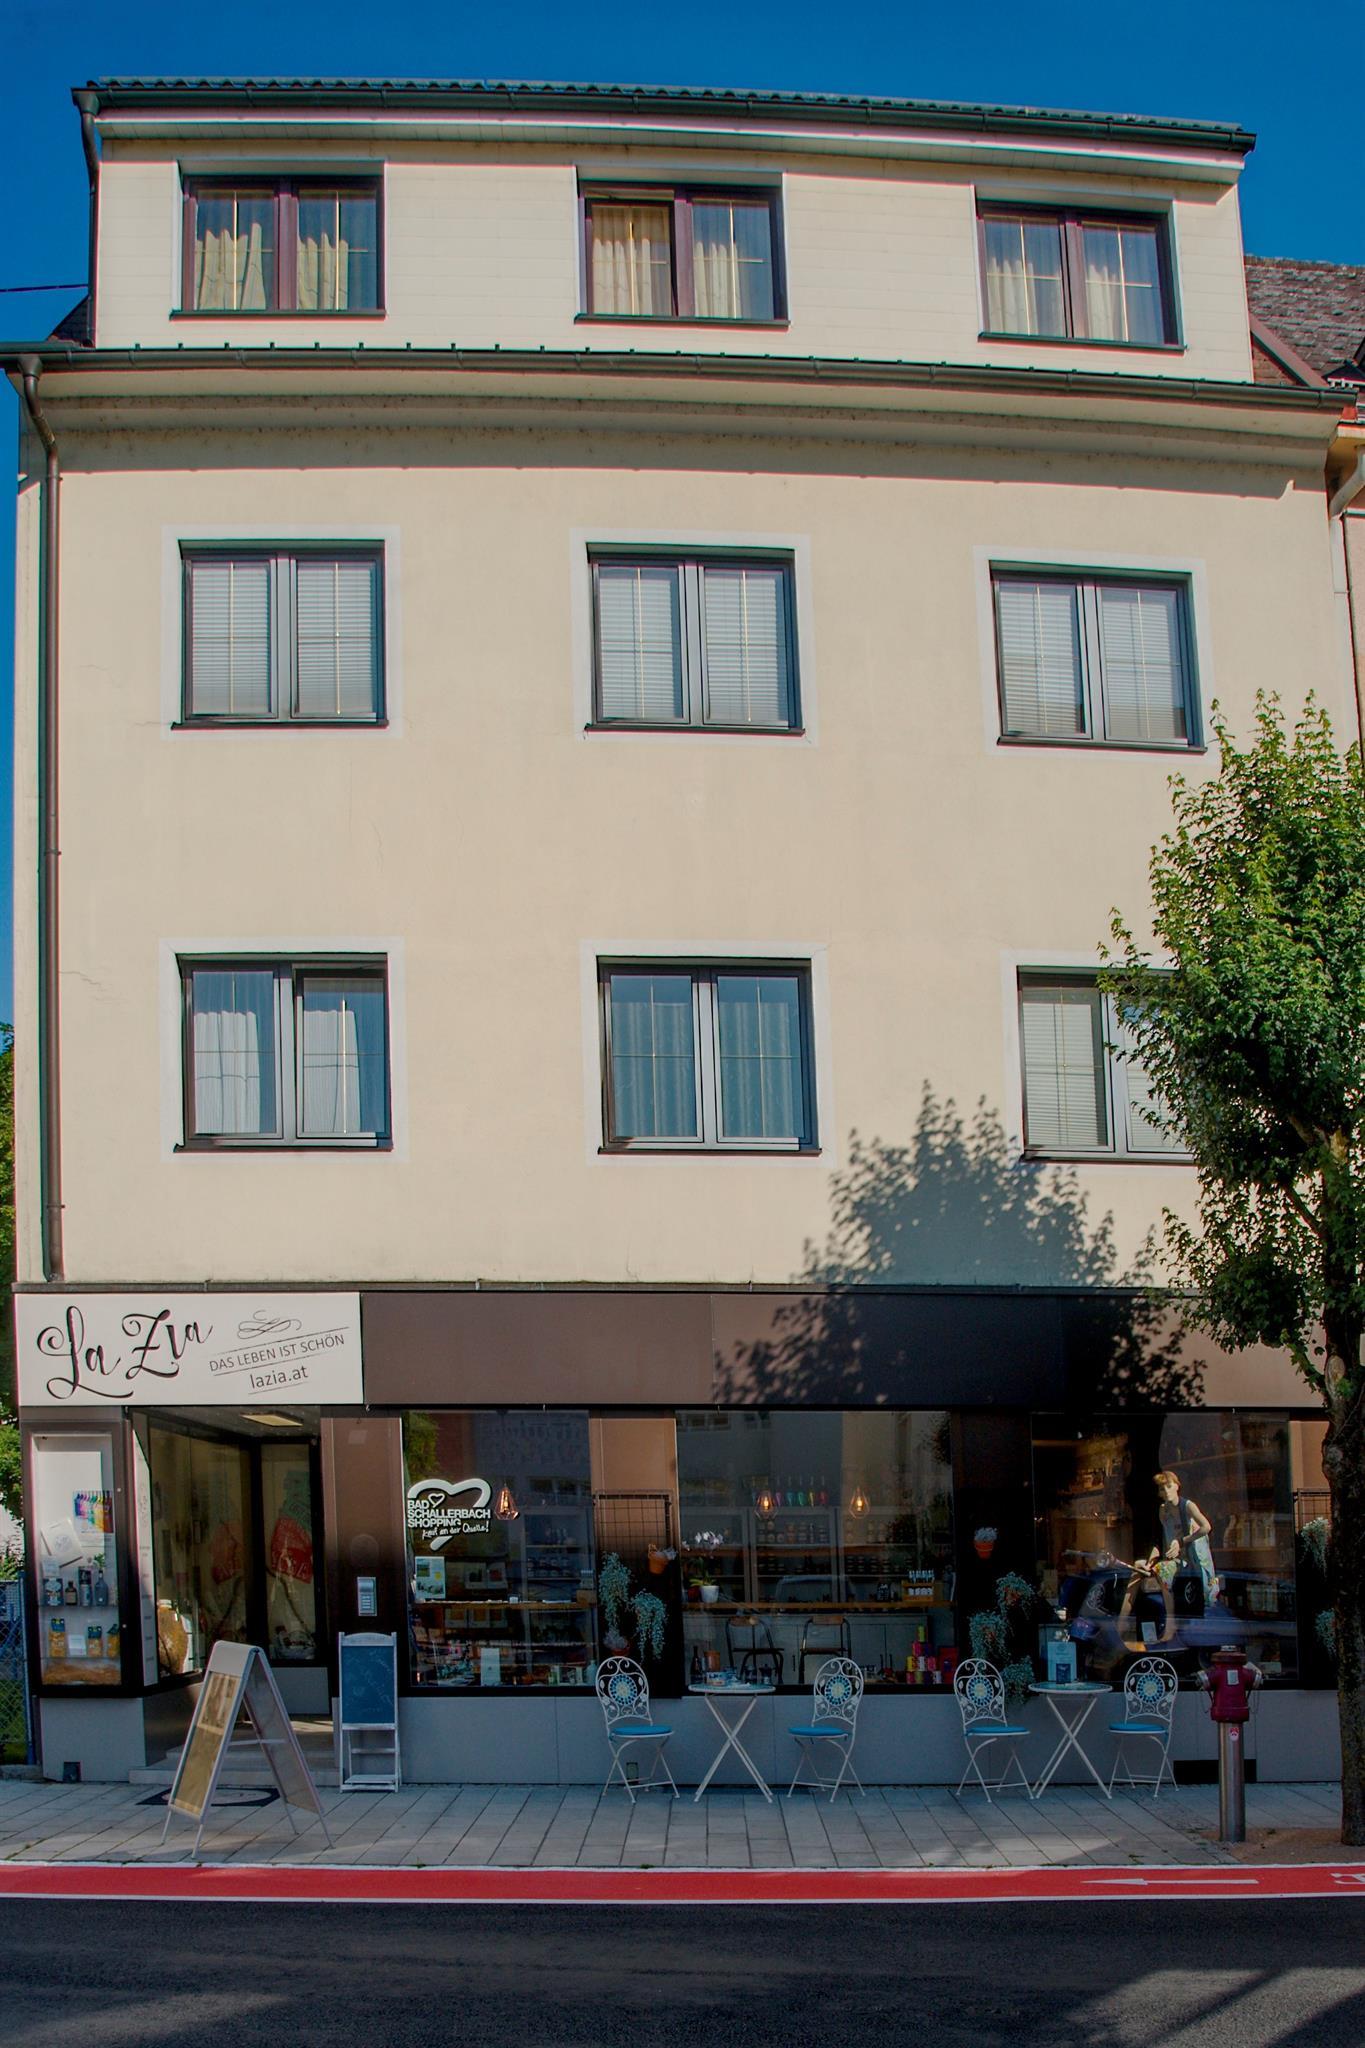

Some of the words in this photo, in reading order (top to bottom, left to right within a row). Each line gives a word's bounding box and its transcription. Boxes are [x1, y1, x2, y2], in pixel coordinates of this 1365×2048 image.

[37, 1306, 134, 1399] La
[121, 1309, 213, 1379] Zia
[209, 1355, 235, 1373] DAS
[237, 1348, 276, 1367] LEBEN
[279, 1344, 298, 1359] IST
[300, 1333, 345, 1354] SCHÖN
[249, 1364, 309, 1390] lazia.at
[408, 1500, 429, 1509] BAD
[408, 1509, 490, 1518] SCHALLERBACH
[408, 1518, 461, 1527] SHOPPING
